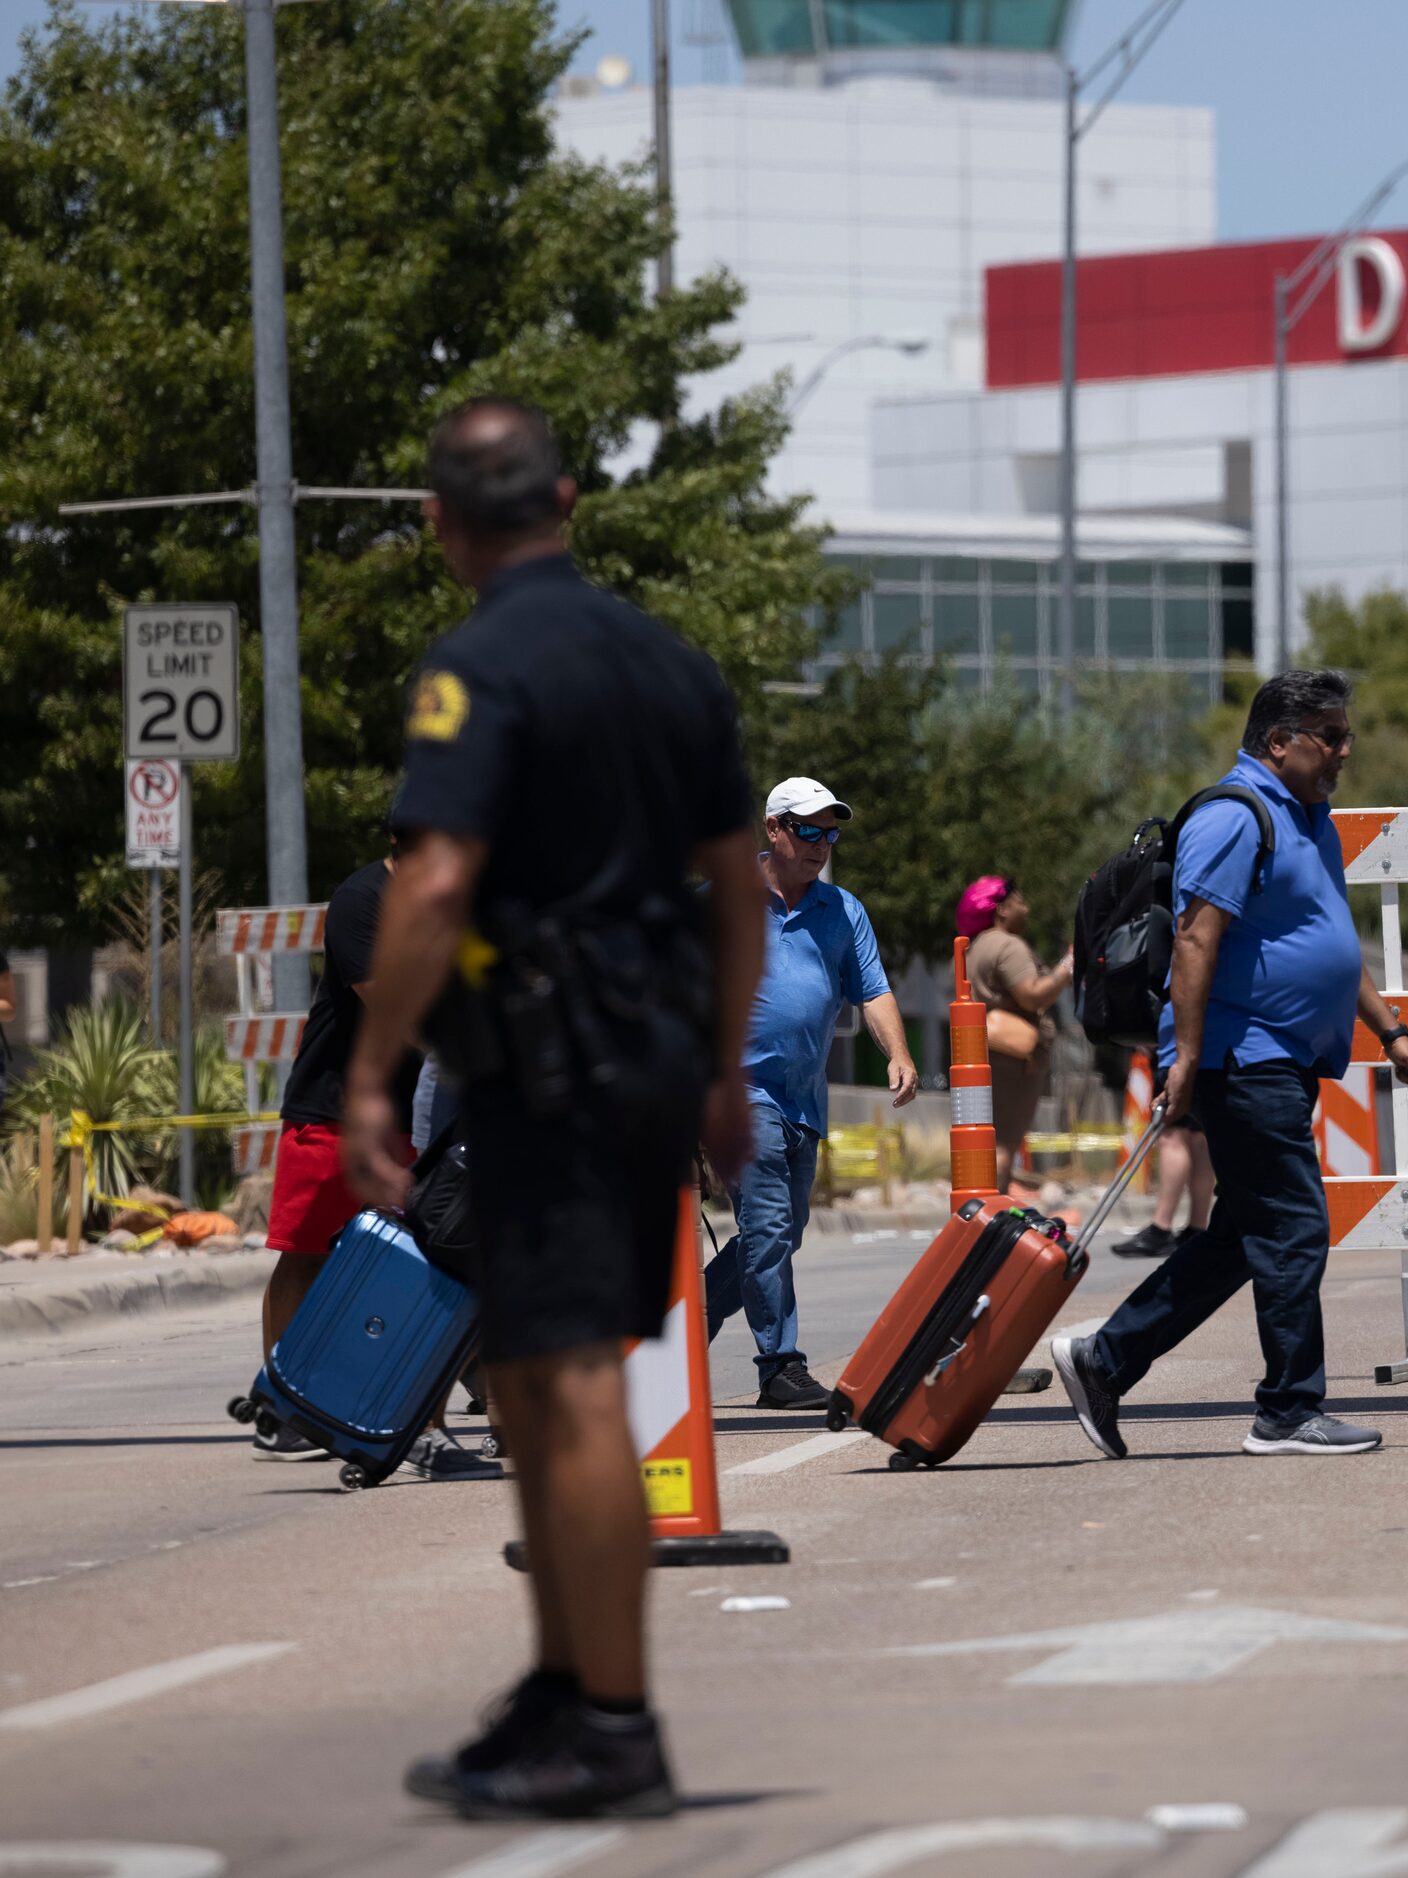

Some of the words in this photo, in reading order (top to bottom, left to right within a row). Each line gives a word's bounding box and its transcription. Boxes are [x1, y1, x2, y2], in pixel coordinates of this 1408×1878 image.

[137, 621, 224, 647] SPEED
[147, 653, 213, 678] LIMIT
[138, 688, 224, 743] 20
[137, 812, 173, 826] ANY
[136, 830, 173, 847] TIME
